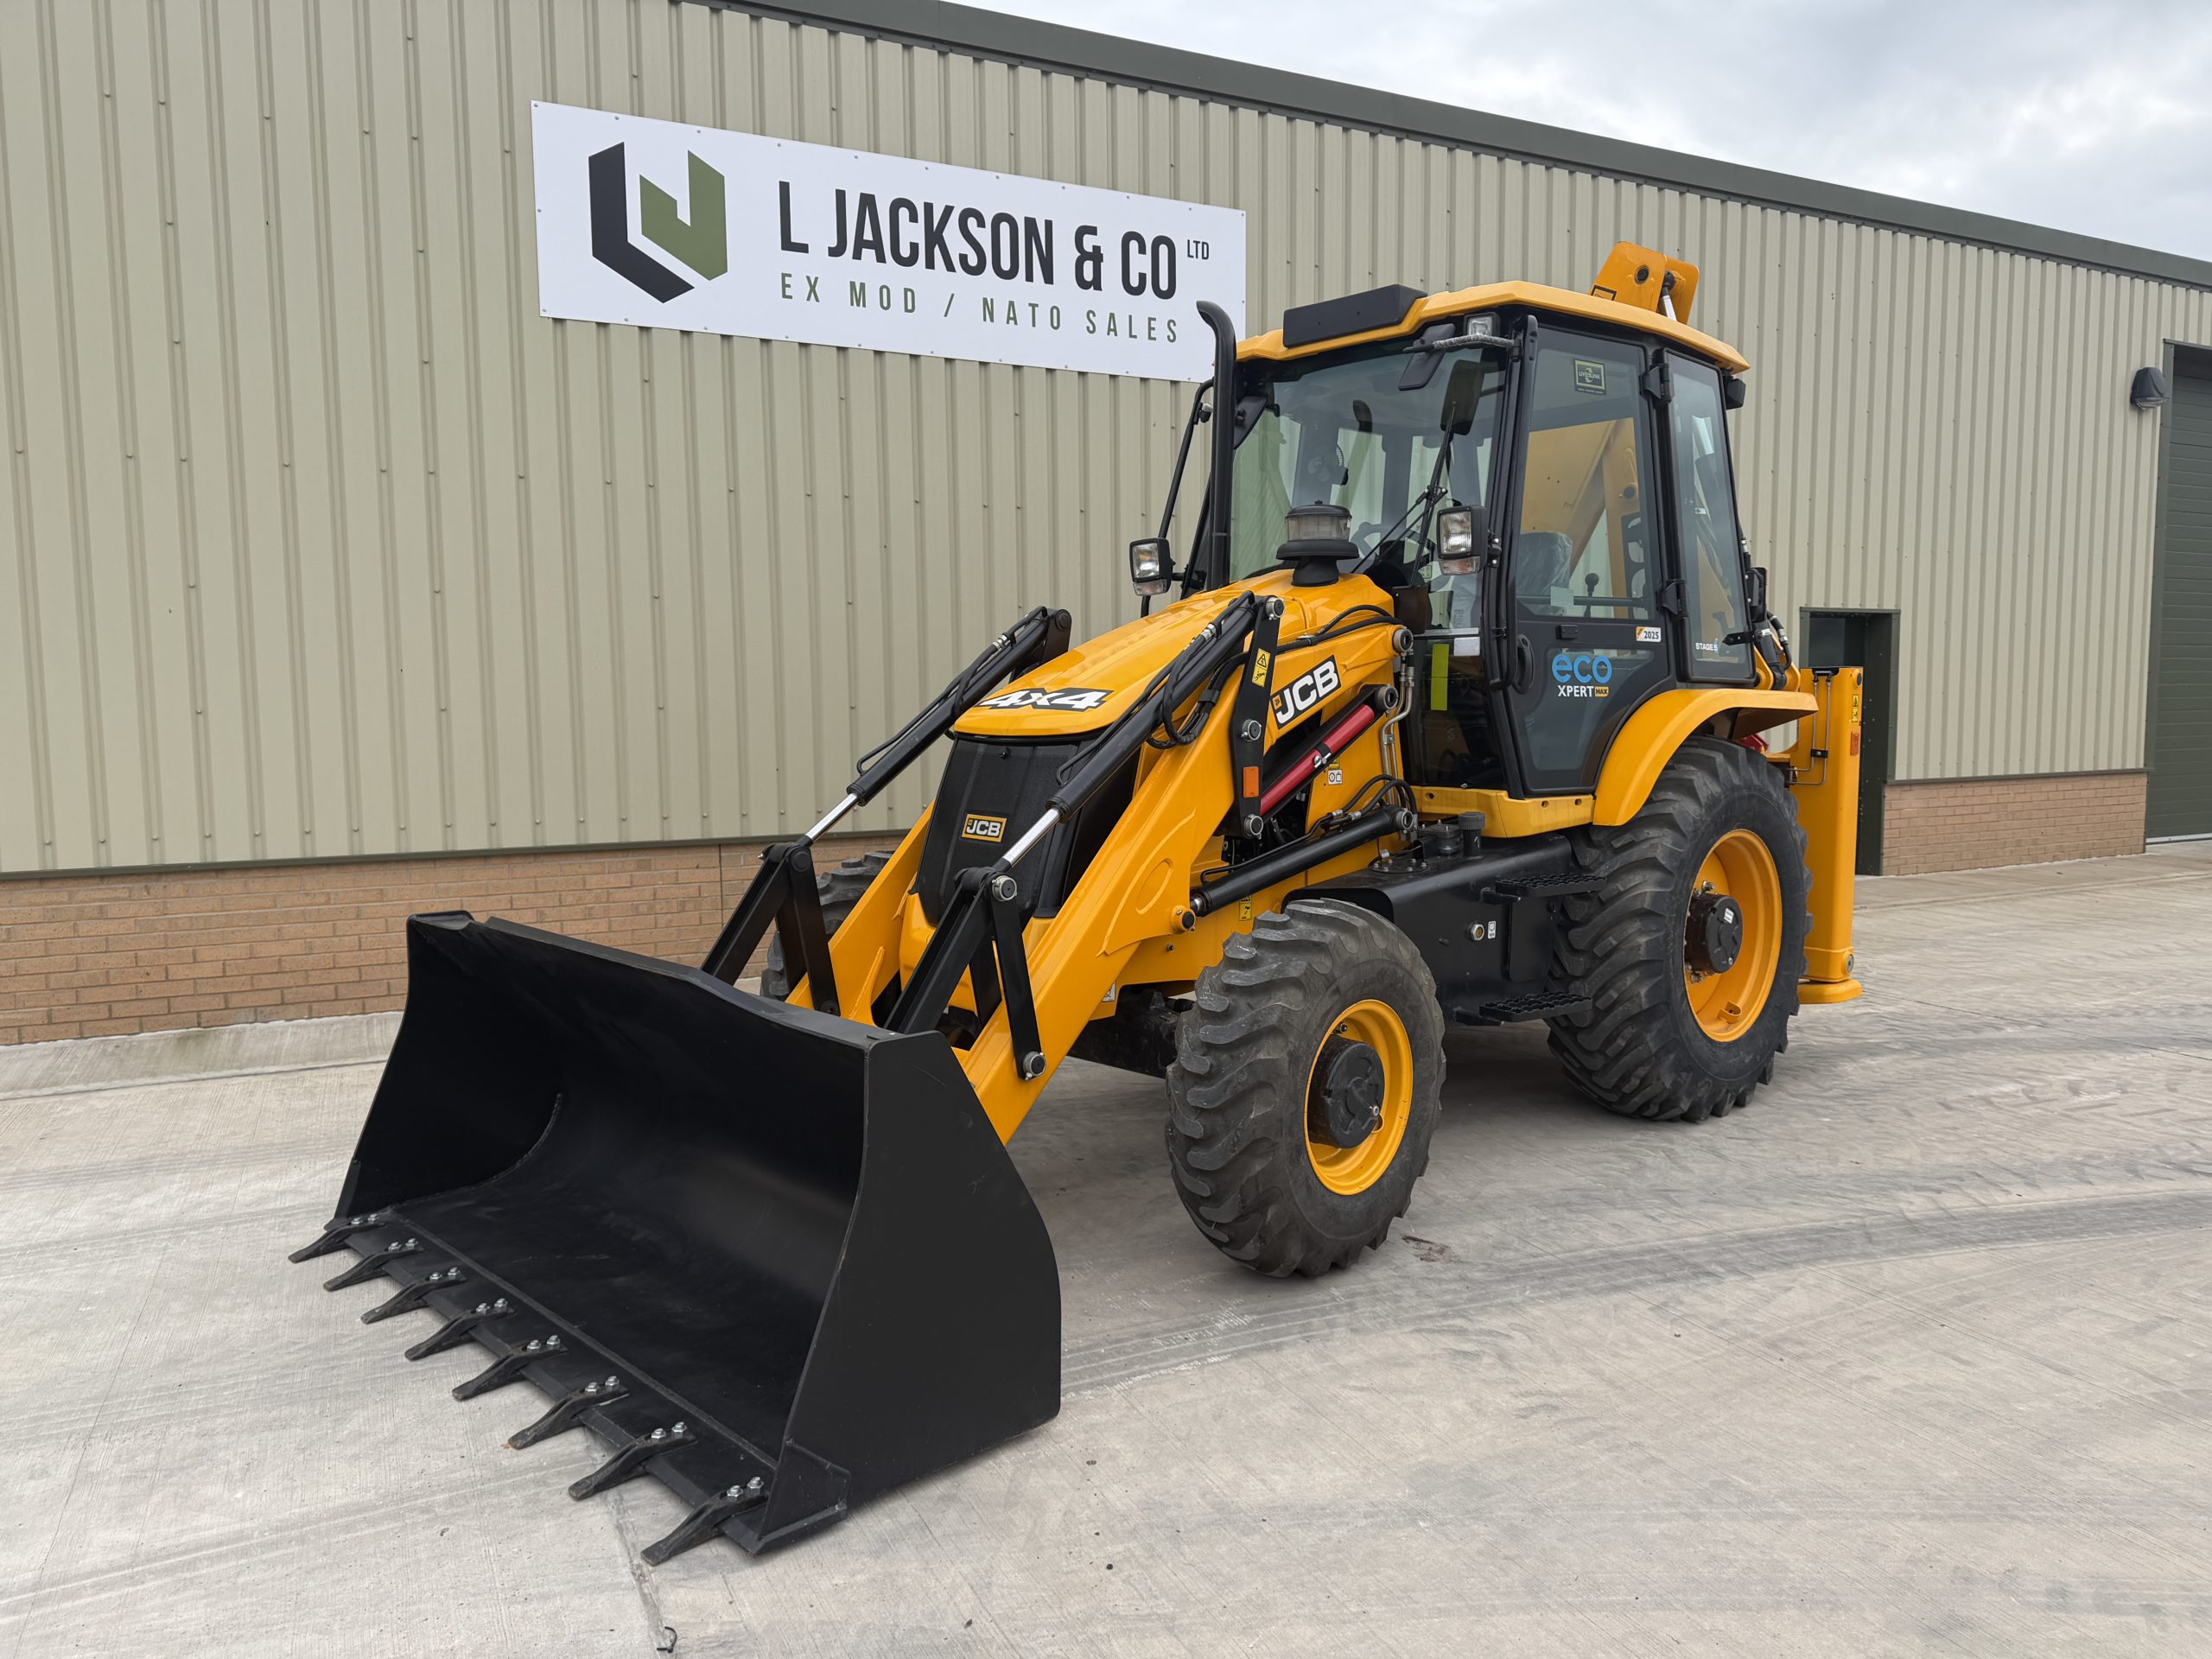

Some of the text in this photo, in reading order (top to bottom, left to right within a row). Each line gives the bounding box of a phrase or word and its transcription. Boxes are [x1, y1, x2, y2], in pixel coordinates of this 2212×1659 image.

[779, 181, 1209, 300] L JACKSON & CO LTD
[781, 273, 819, 302] EX
[850, 281, 915, 313] MOD
[982, 297, 1060, 330] NATO
[1086, 310, 1176, 342] SALES
[1643, 631, 1659, 639] 2025
[1695, 642, 1713, 651] STAGE
[1552, 653, 1612, 683] eco
[1276, 660, 1338, 724] JCB
[1557, 685, 1594, 697] XPERT
[966, 820, 1001, 836] JCB
